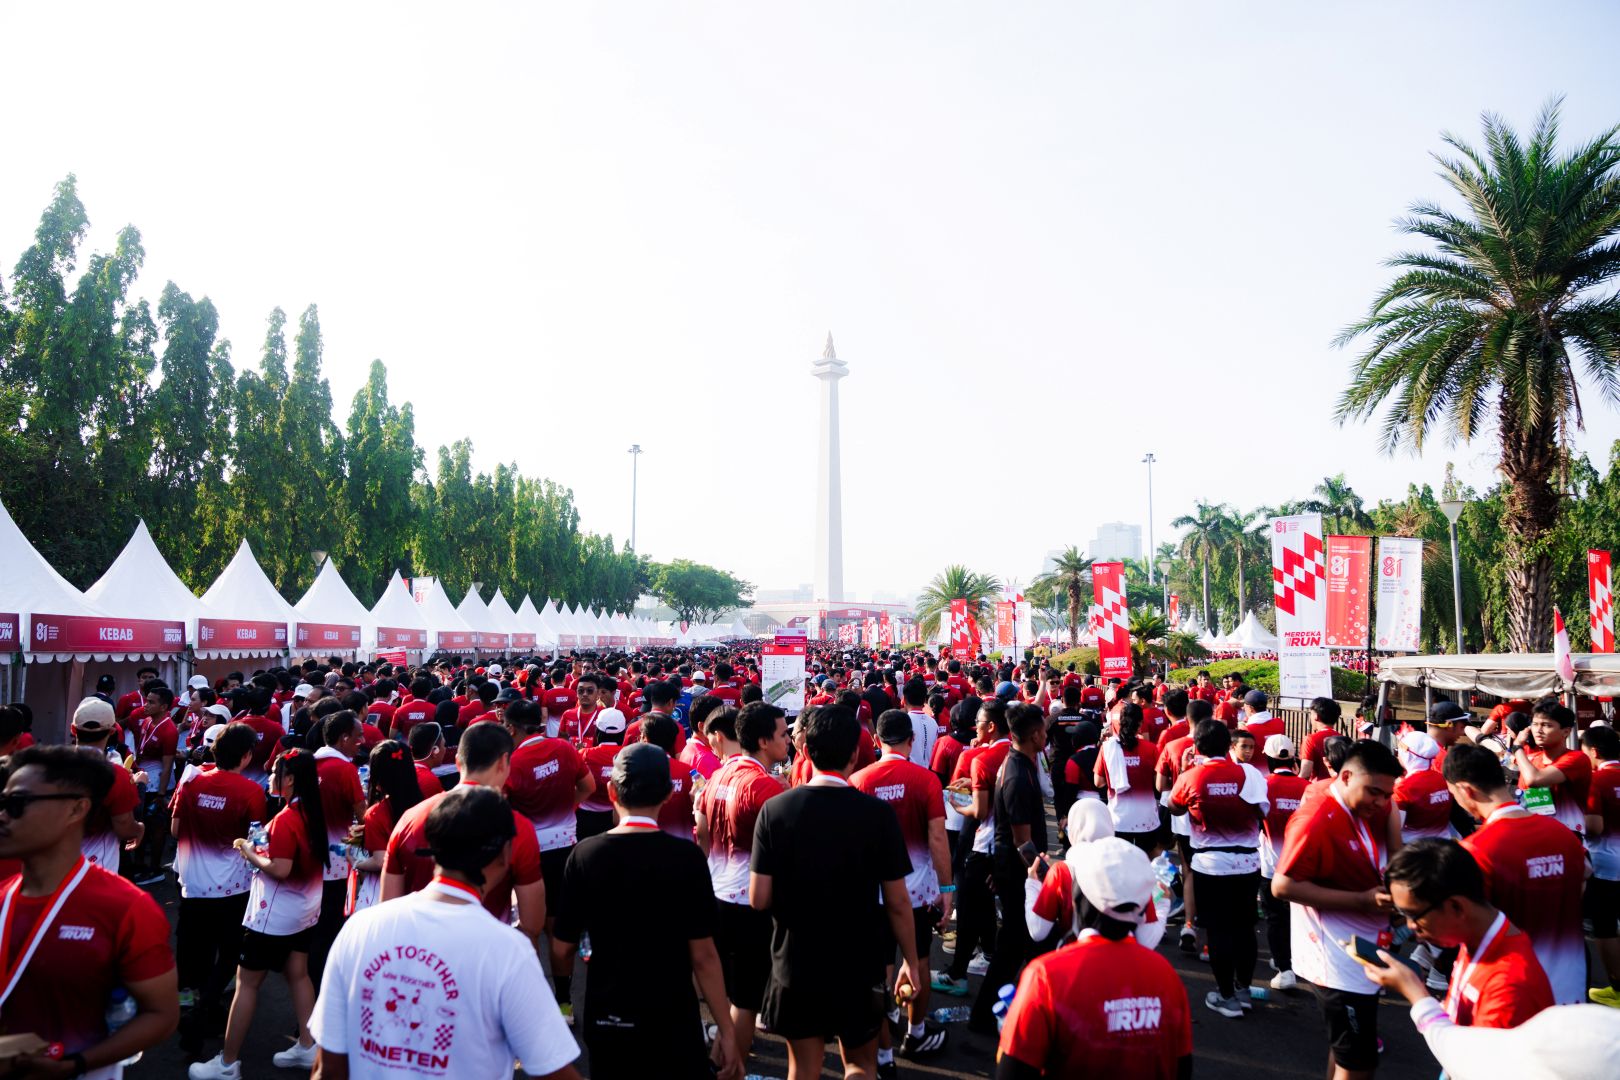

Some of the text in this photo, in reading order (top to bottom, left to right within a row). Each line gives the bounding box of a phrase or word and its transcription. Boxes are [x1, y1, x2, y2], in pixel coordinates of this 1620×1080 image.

[1275, 521, 1286, 534] 81
[1095, 566, 1102, 575] 81
[1331, 555, 1351, 578] 81
[1383, 556, 1403, 578] 81
[36, 622, 48, 643] 81
[99, 628, 133, 641] KEBAB
[165, 633, 182, 642] RUN
[201, 626, 208, 641] 81
[236, 628, 257, 640] KEBAB
[324, 631, 339, 640] KEBAB
[1289, 637, 1321, 646] RUN
[1106, 660, 1127, 668] RUN
[536, 763, 559, 780] RUN
[874, 783, 905, 792] MERDEKA
[1210, 787, 1238, 796] RUN
[198, 792, 227, 801] MERDEKA
[879, 789, 905, 801] RUN
[200, 798, 226, 810] RUN
[1526, 854, 1564, 866] MERDEKA
[1530, 862, 1564, 878] RUN
[61, 930, 94, 941] RUN
[364, 945, 459, 1001] RUN TOGETHER
[1104, 996, 1161, 1013] MERDEKA
[1110, 1008, 1161, 1032] RUN
[360, 1036, 449, 1069] NINETEN
